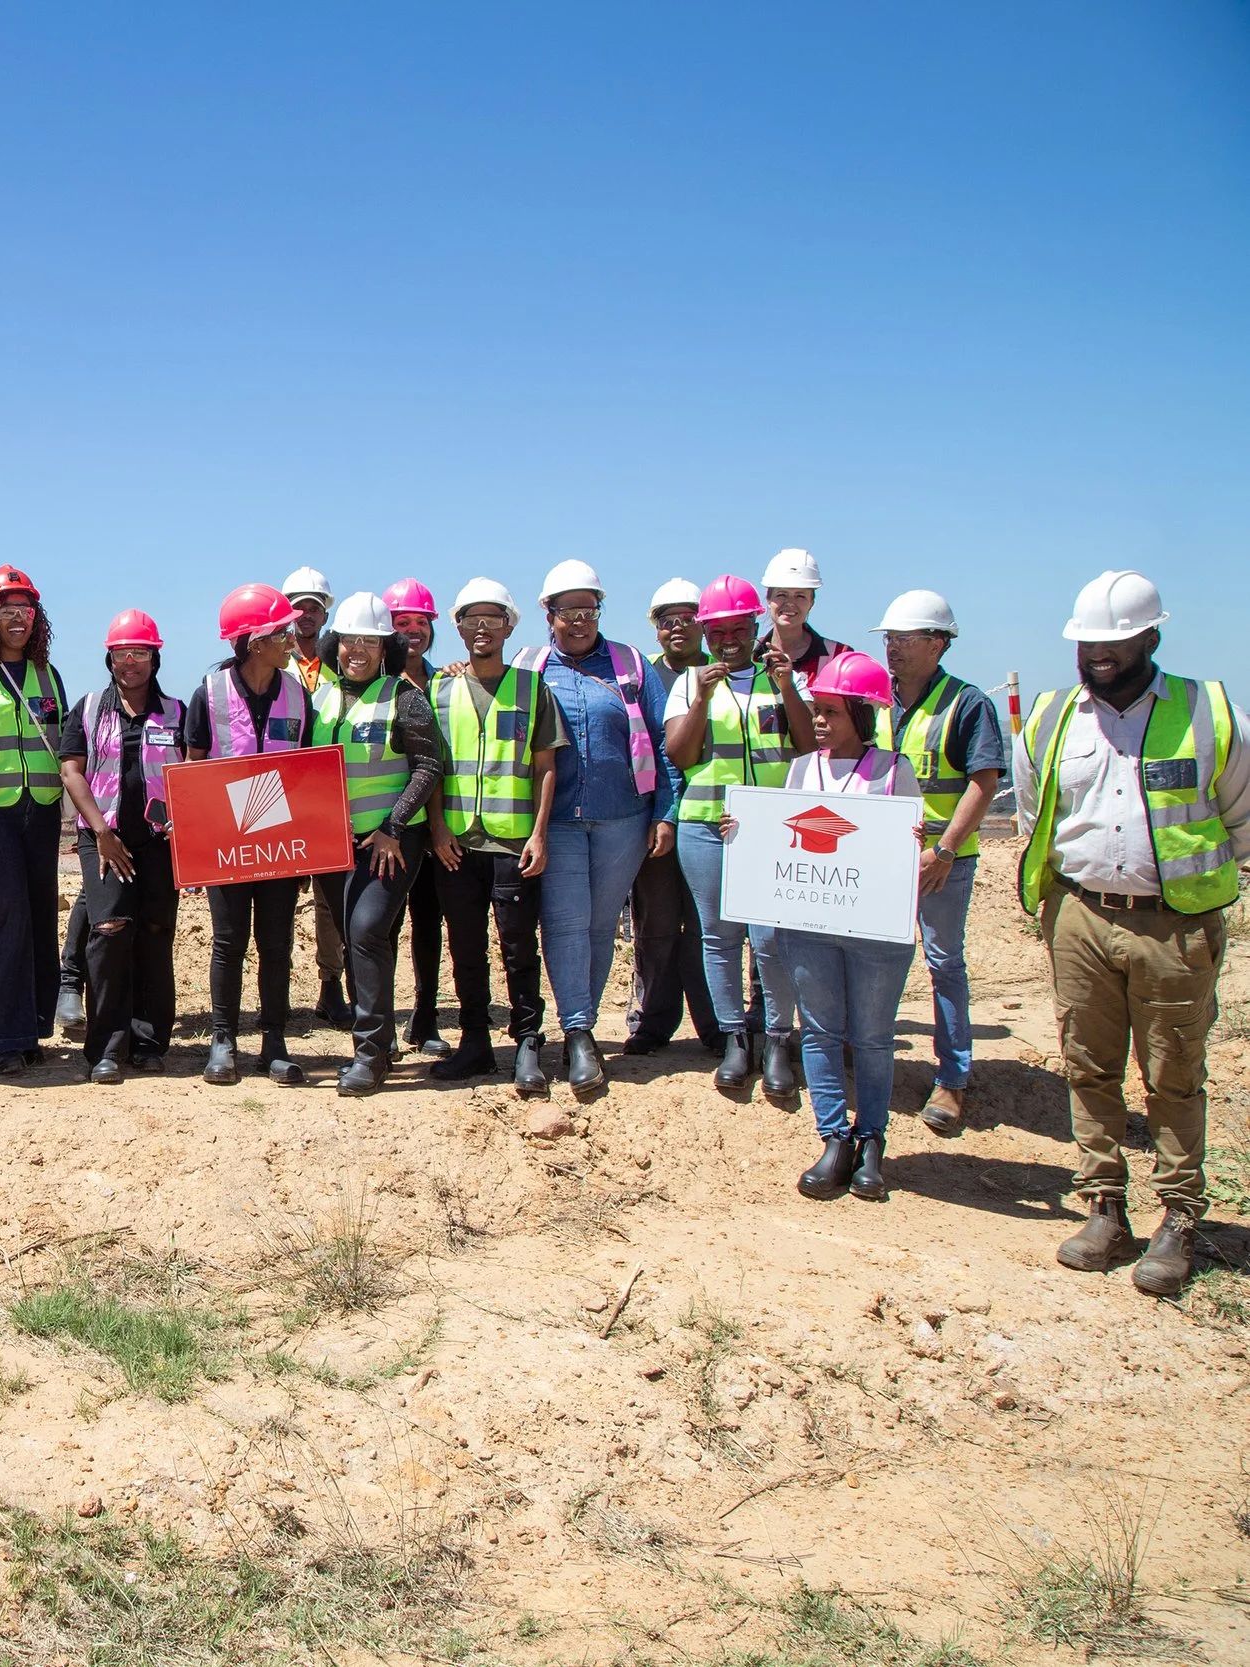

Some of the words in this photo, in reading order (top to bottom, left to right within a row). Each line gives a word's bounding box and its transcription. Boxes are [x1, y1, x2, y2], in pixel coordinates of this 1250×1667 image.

[217, 839, 307, 868] MENAR
[775, 861, 860, 889] MENAR
[774, 887, 859, 907] ACADEMY
